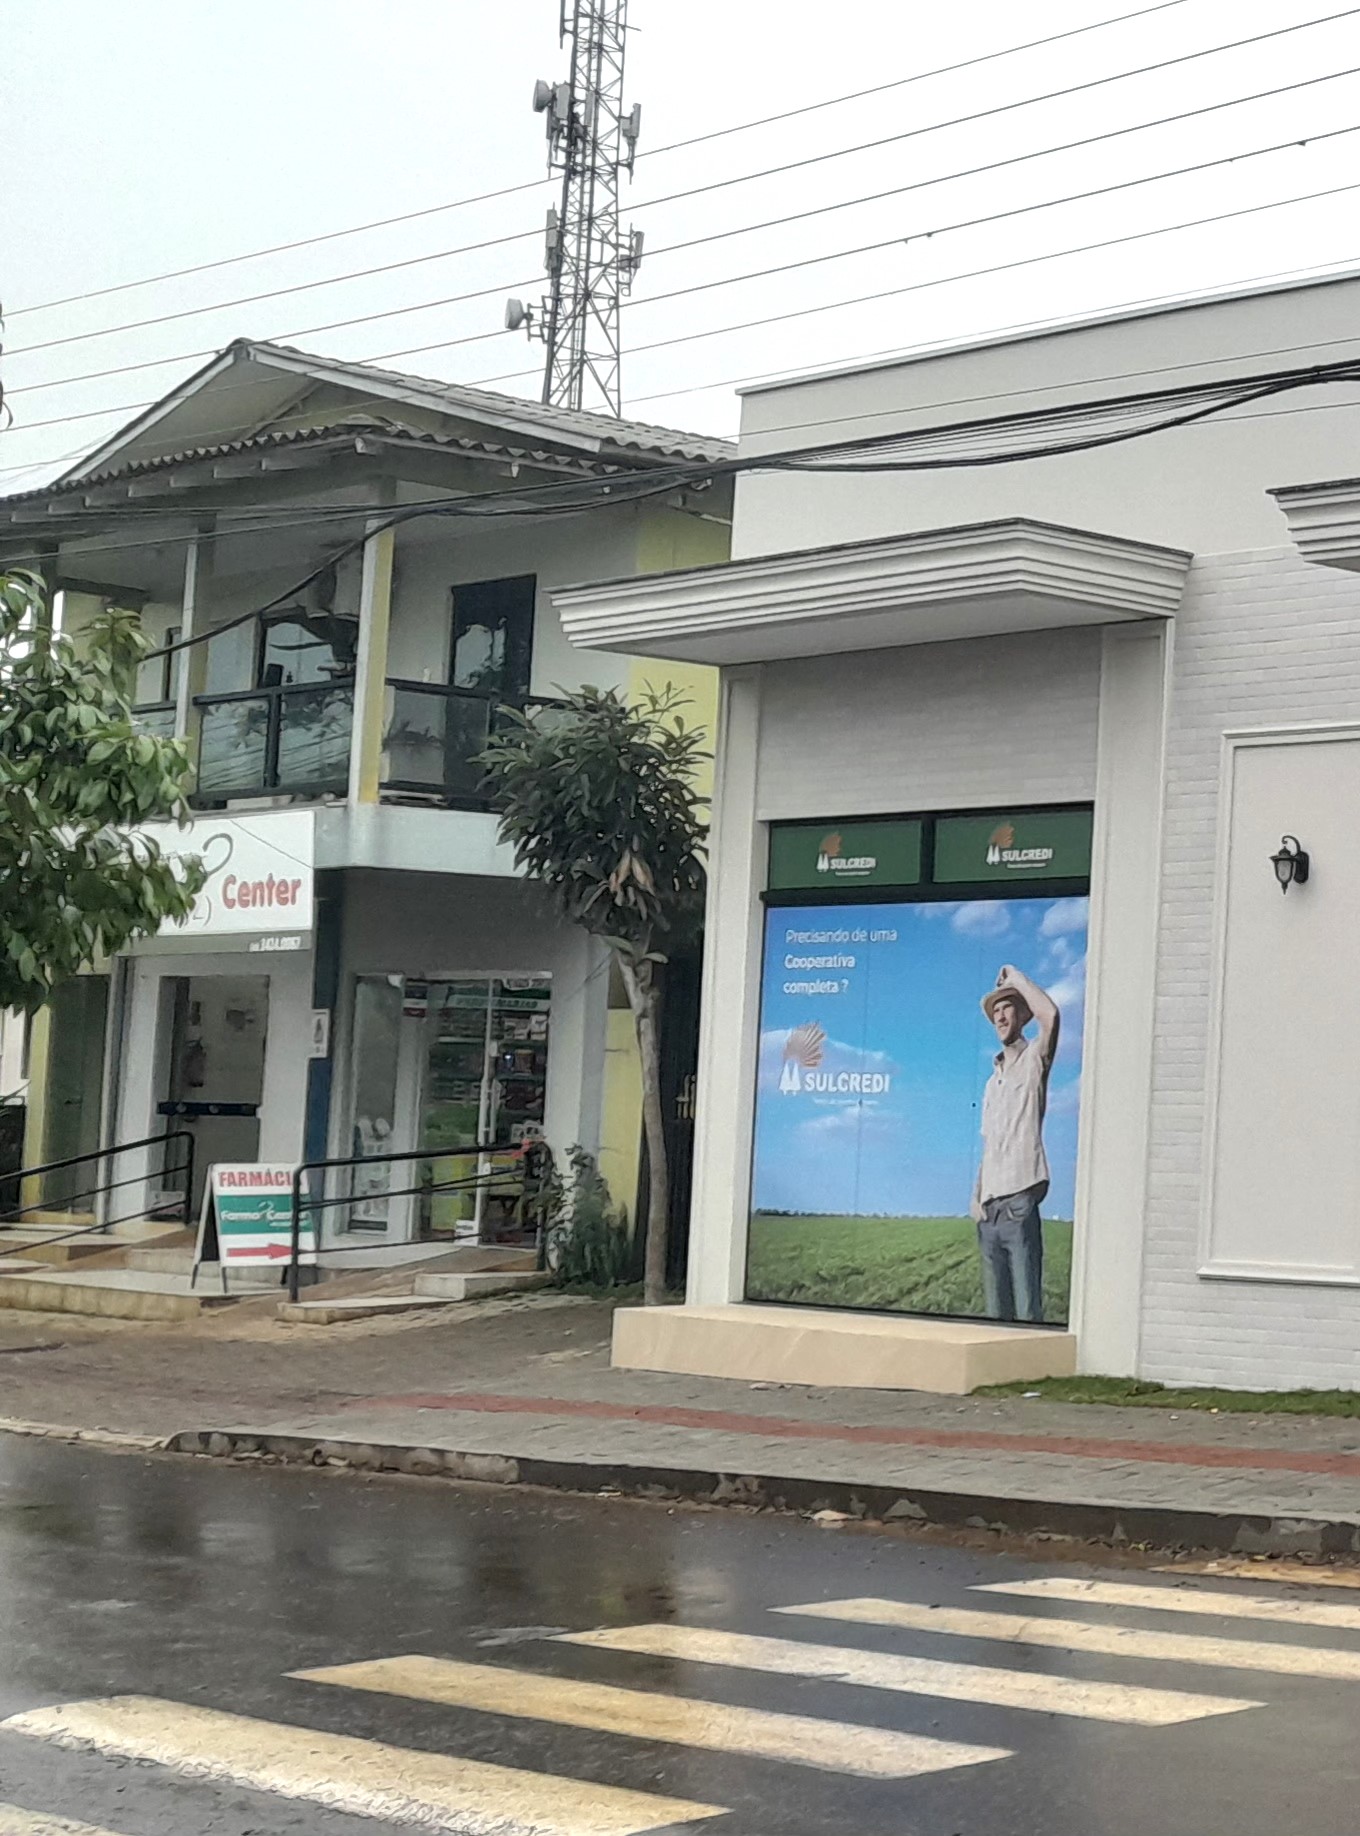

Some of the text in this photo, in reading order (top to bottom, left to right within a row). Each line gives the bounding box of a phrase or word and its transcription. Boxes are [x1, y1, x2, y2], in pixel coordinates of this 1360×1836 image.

[830, 857, 877, 870] SULCREDI
[1002, 848, 1053, 862] SULCREDI
[222, 872, 302, 910] Center
[785, 926, 898, 944] Precisando de uma
[784, 953, 856, 970] Cooperativa
[783, 979, 839, 995] completa
[804, 1072, 891, 1094] SULCREDI
[218, 1168, 301, 1187] FARMÁCI
